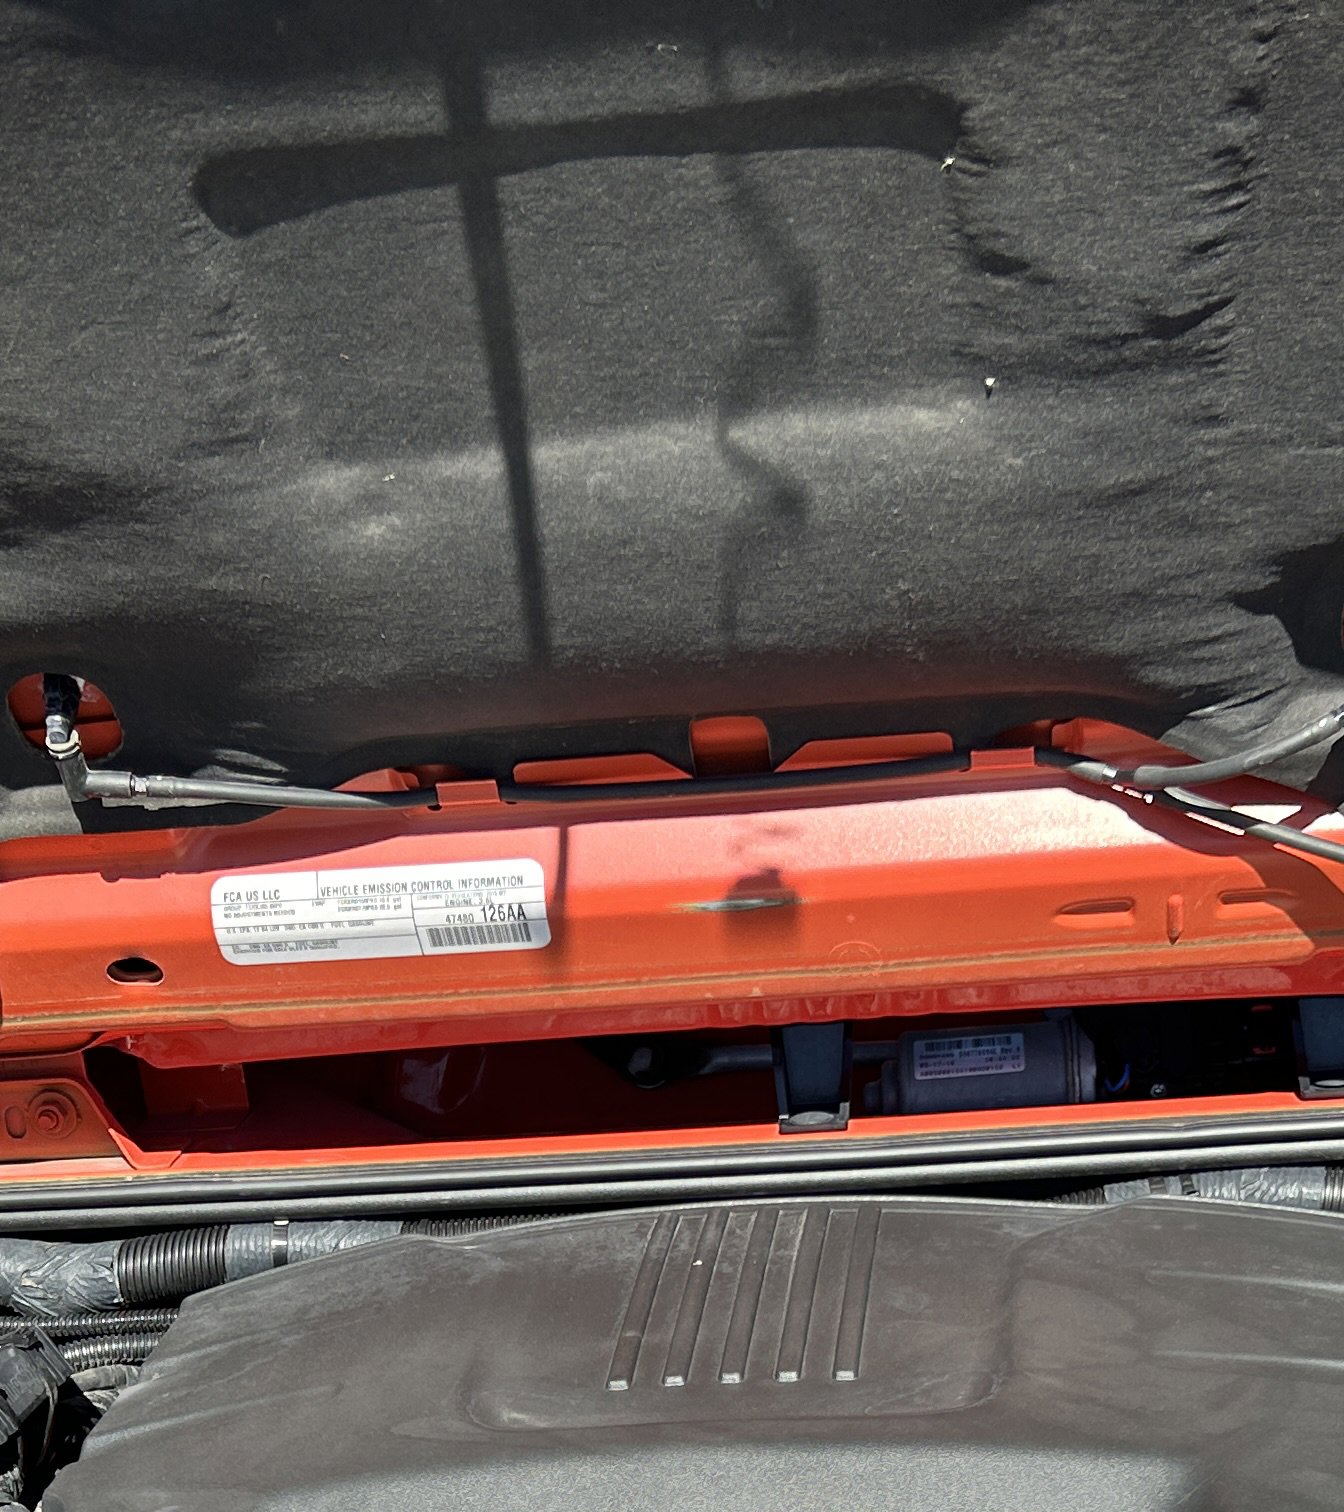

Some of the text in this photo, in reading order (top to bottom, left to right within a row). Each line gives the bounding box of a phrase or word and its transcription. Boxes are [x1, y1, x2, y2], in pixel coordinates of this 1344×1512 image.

[223, 889, 281, 903] FCA US LLC
[320, 875, 524, 898] VEHICLE EMISSION CONTROL INFORMATION
[481, 904, 527, 923] 126AA
